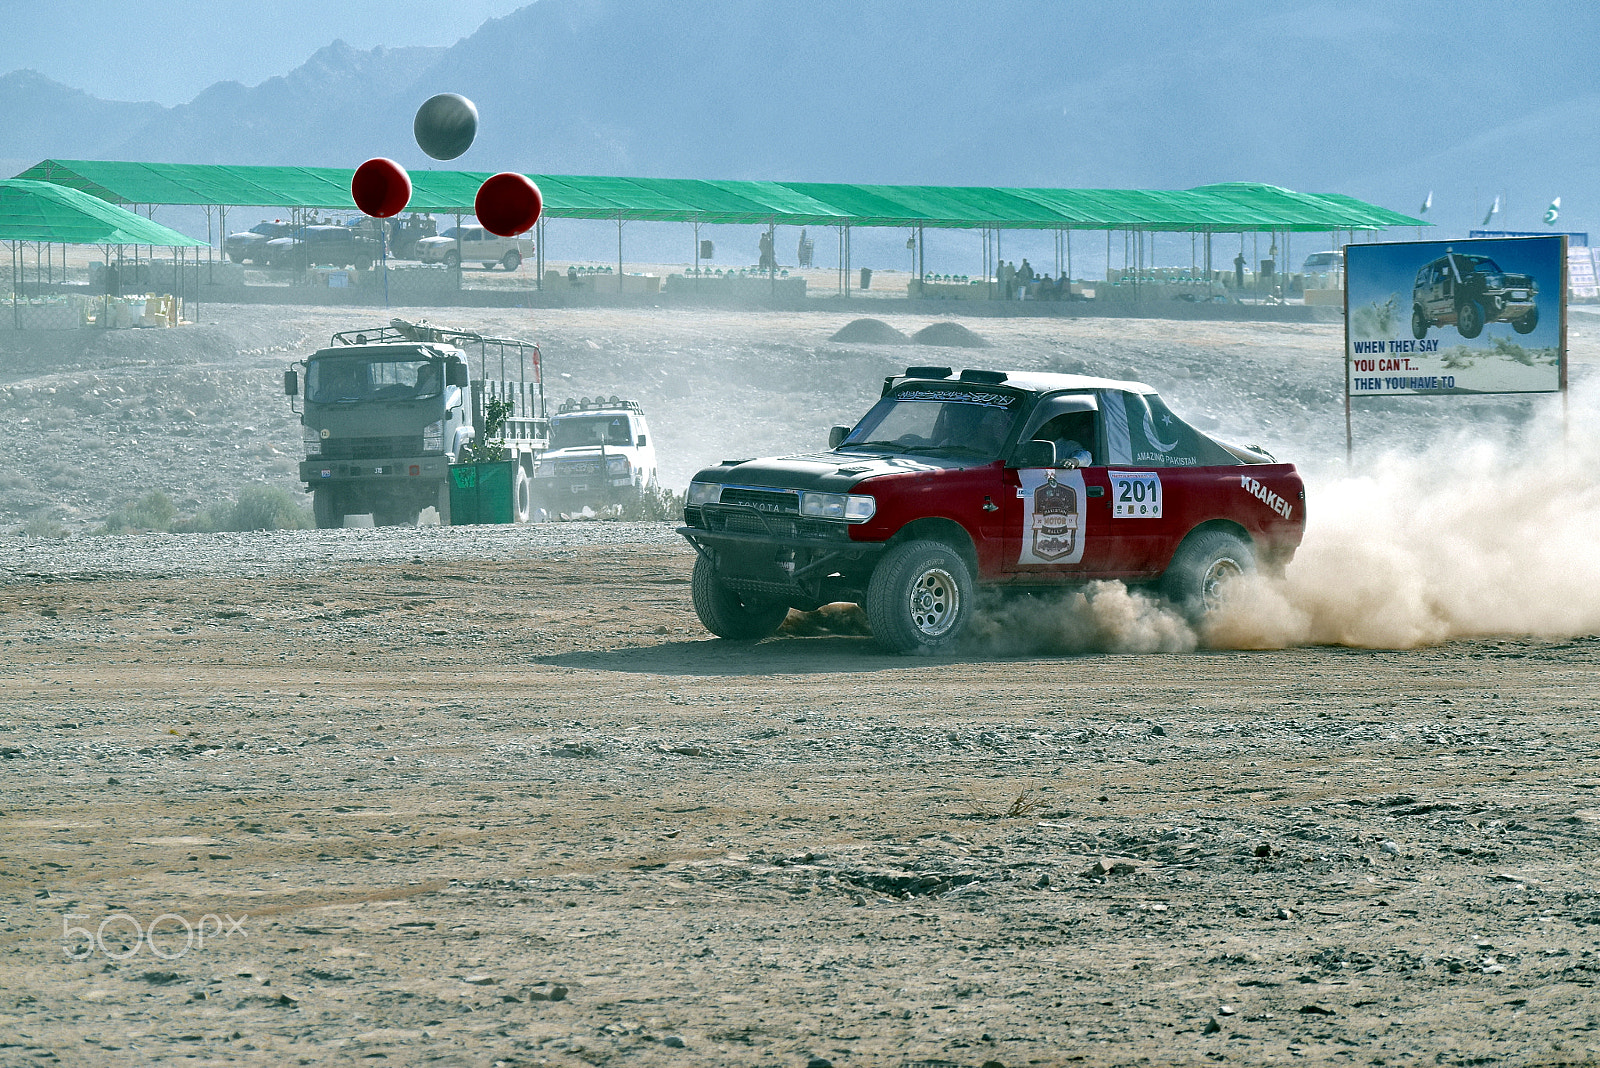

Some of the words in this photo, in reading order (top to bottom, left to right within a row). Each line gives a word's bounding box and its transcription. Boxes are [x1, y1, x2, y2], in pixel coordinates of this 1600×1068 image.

[1354, 341, 1385, 353] WHEN
[1389, 340, 1416, 352] THEY
[1420, 339, 1439, 352] SAY
[1354, 360, 1375, 372] YOU
[1379, 358, 1419, 371] CAN'T...
[1354, 378, 1381, 390] THEN
[1385, 377, 1406, 389] YOU
[1410, 376, 1438, 389] HAVE
[1441, 375, 1455, 388] TO
[1136, 451, 1165, 463] AMAZING
[1166, 455, 1197, 466] PAKISTAN
[1118, 480, 1157, 502] 201
[1240, 475, 1293, 520] KRAKEN
[738, 501, 780, 512] TOYOTA
[1044, 516, 1067, 525] MOTOR
